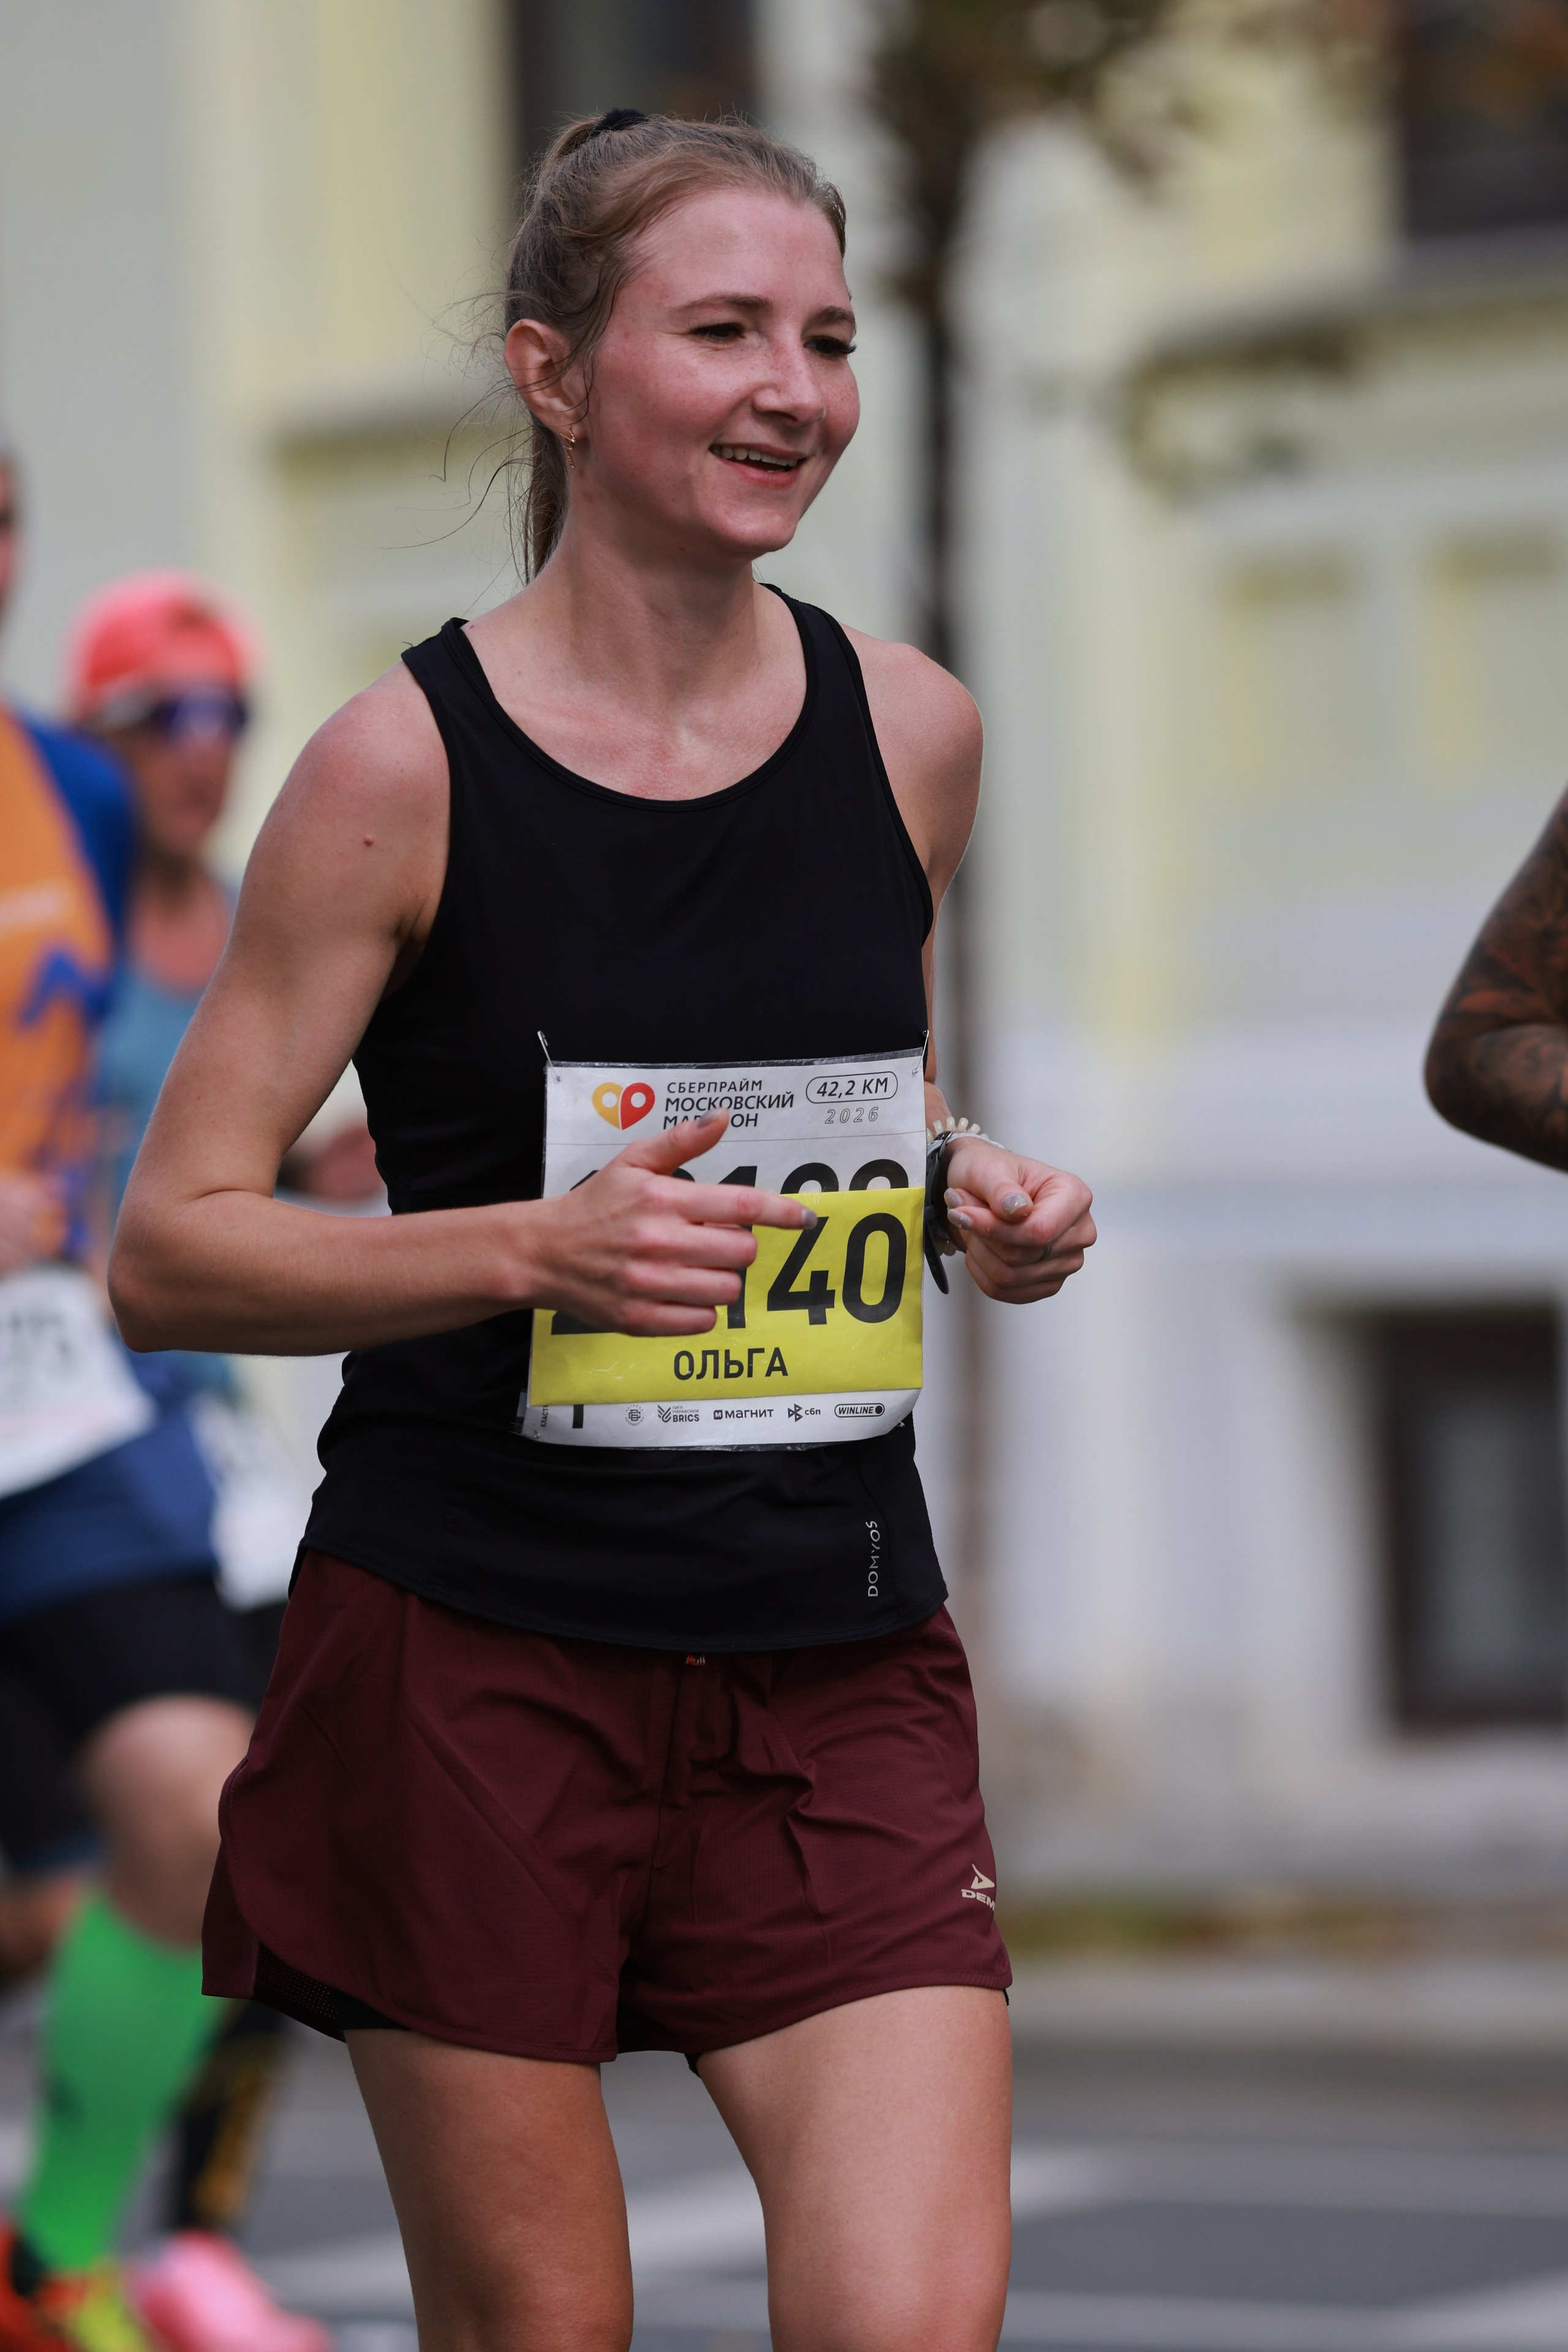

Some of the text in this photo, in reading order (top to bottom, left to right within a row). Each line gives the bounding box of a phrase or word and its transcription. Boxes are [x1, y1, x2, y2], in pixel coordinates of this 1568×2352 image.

[667, 1078, 763, 1094] СБЕРПРАЙМ
[816, 1077, 889, 1099] 42,2 КМ
[665, 1091, 794, 1112] МОСКОВСКИЙ
[824, 1106, 879, 1125] 2026
[674, 1347, 789, 1381] ОЛЬГА
[673, 1414, 699, 1422] BRICS
[839, 1406, 874, 1415] WINLINE
[865, 1521, 880, 1597] DOMYOS
